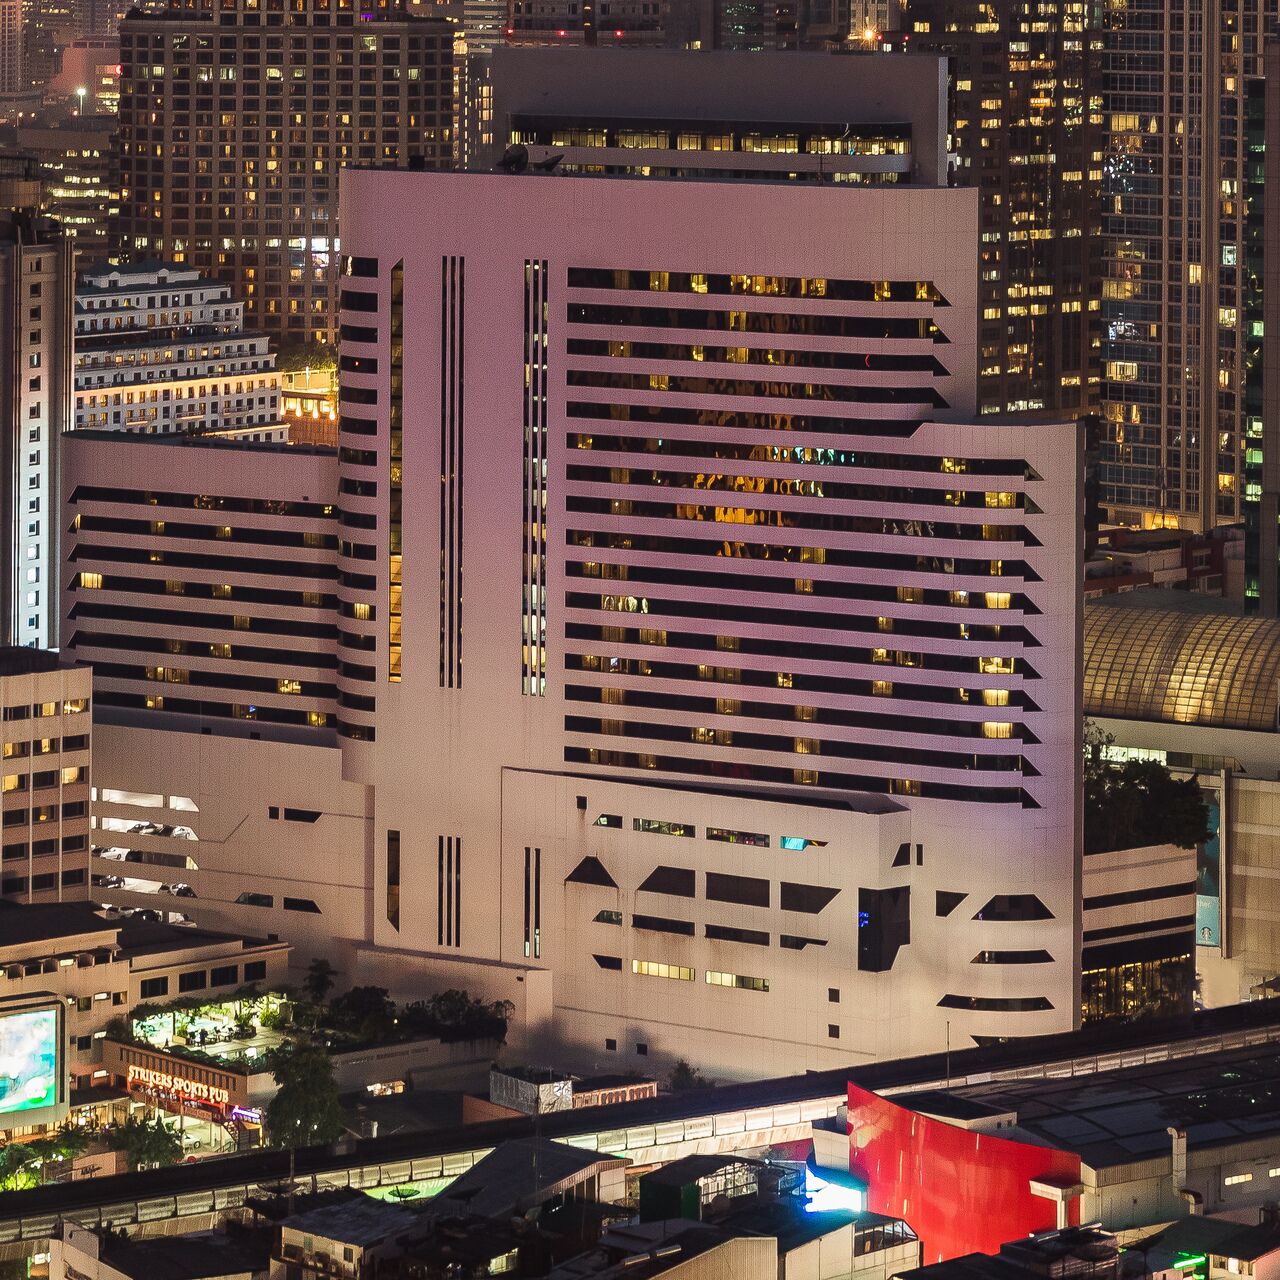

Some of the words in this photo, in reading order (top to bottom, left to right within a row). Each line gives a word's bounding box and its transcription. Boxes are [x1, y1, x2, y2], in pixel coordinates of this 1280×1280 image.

[127, 1064, 174, 1089] STRIKERS
[173, 1077, 210, 1101] SPORTS
[208, 1086, 229, 1104] PUB
